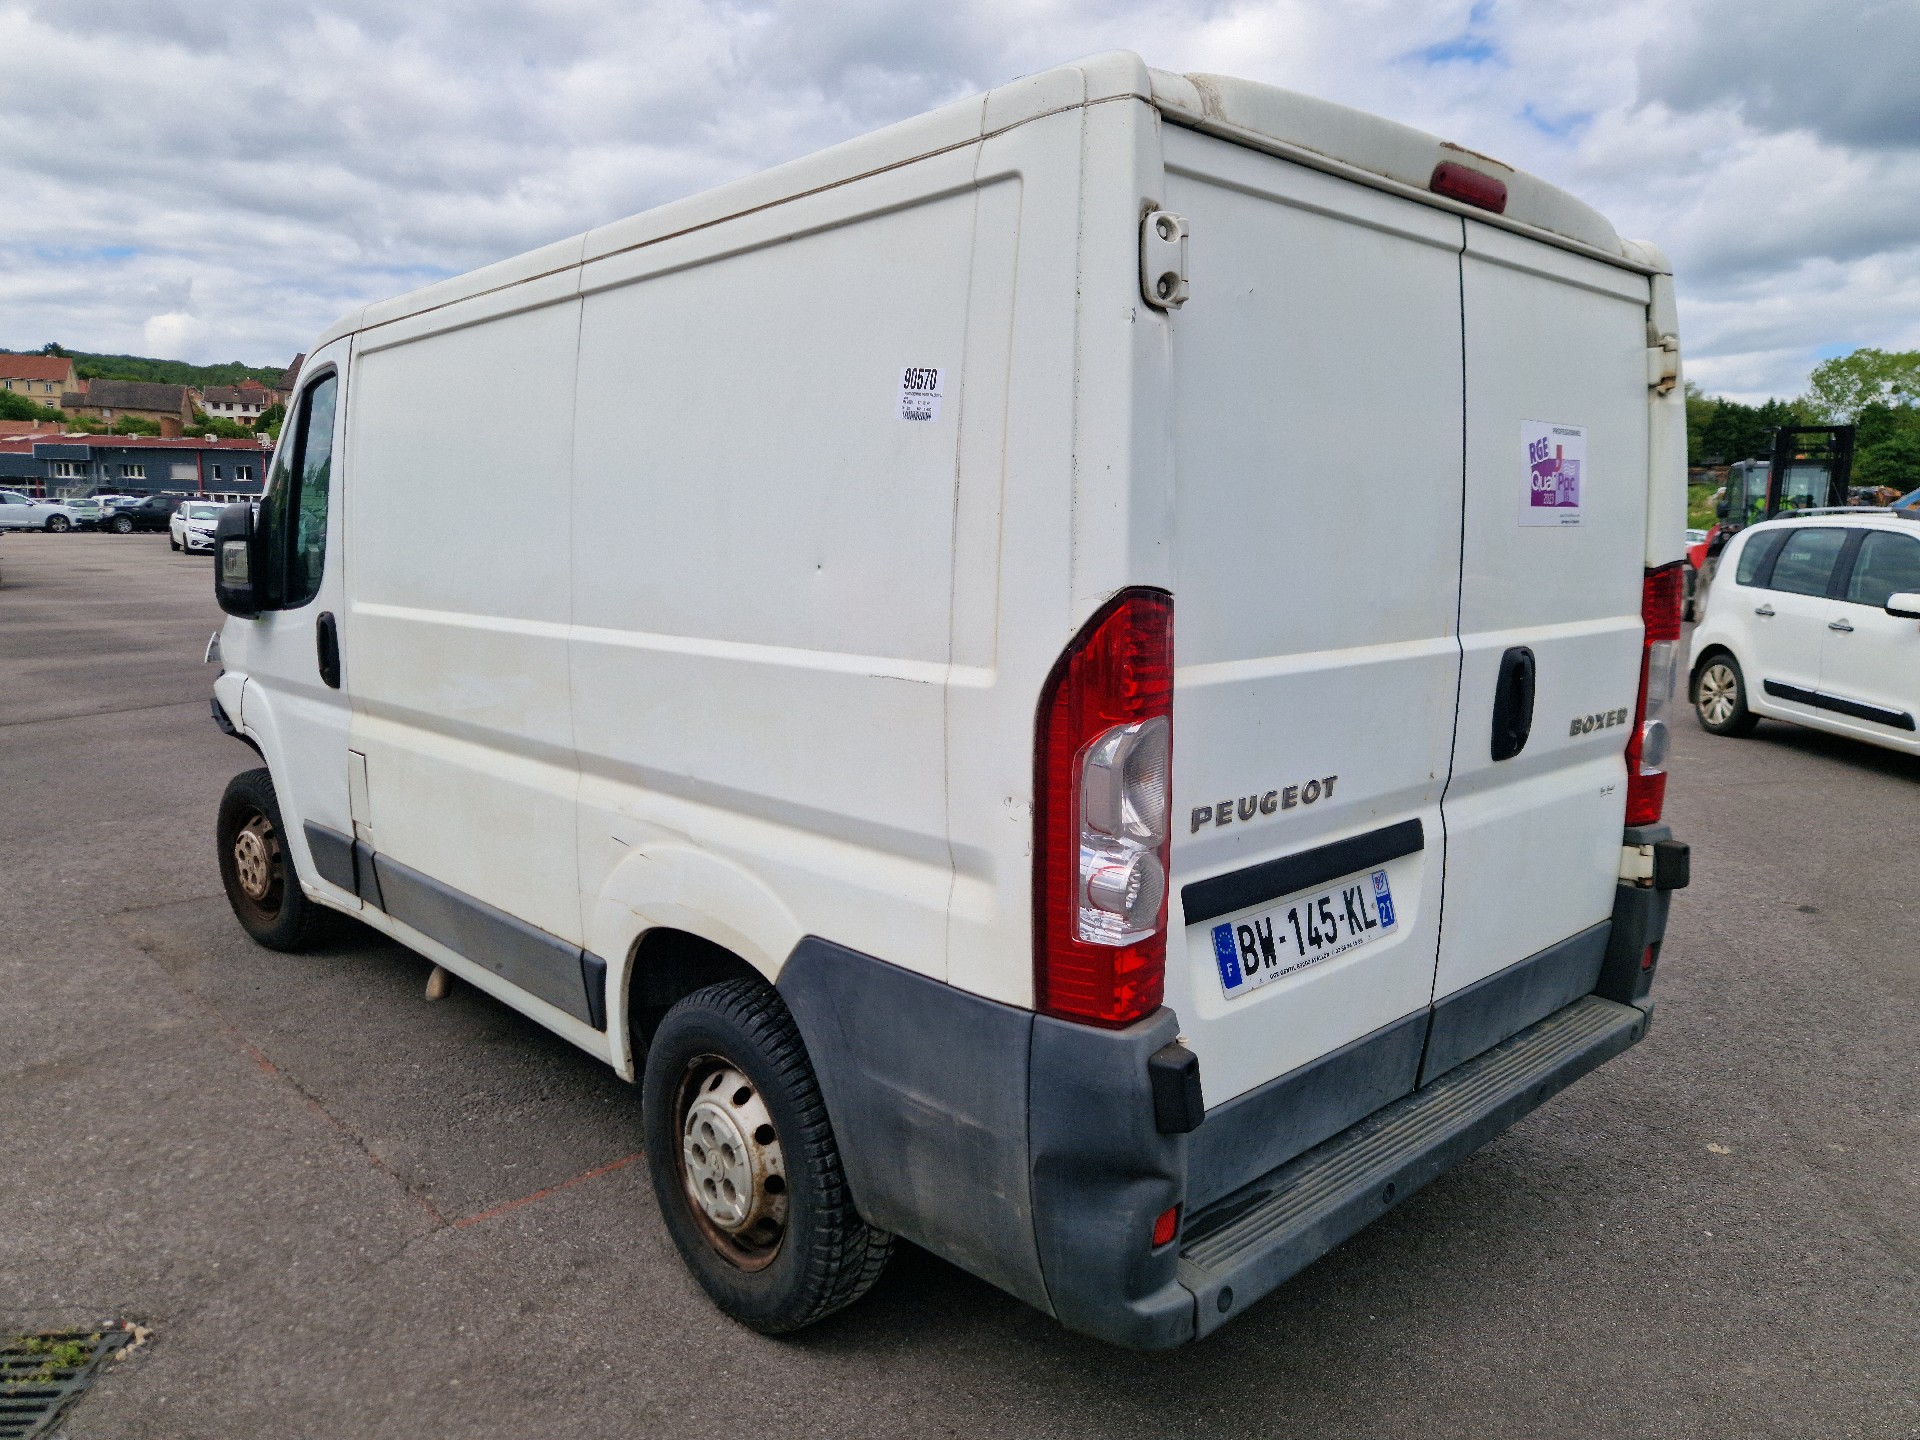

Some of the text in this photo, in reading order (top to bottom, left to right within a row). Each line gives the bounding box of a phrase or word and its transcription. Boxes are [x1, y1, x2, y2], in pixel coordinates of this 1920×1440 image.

[903, 367, 938, 390] 90570
[1529, 437, 1549, 465] RGE
[1569, 706, 1628, 737] BOXER
[1190, 774, 1339, 834] PEUGEOT
[1379, 900, 1394, 924] 21
[1237, 885, 1378, 976] BW-145-KL
[1226, 962, 1233, 977] F
